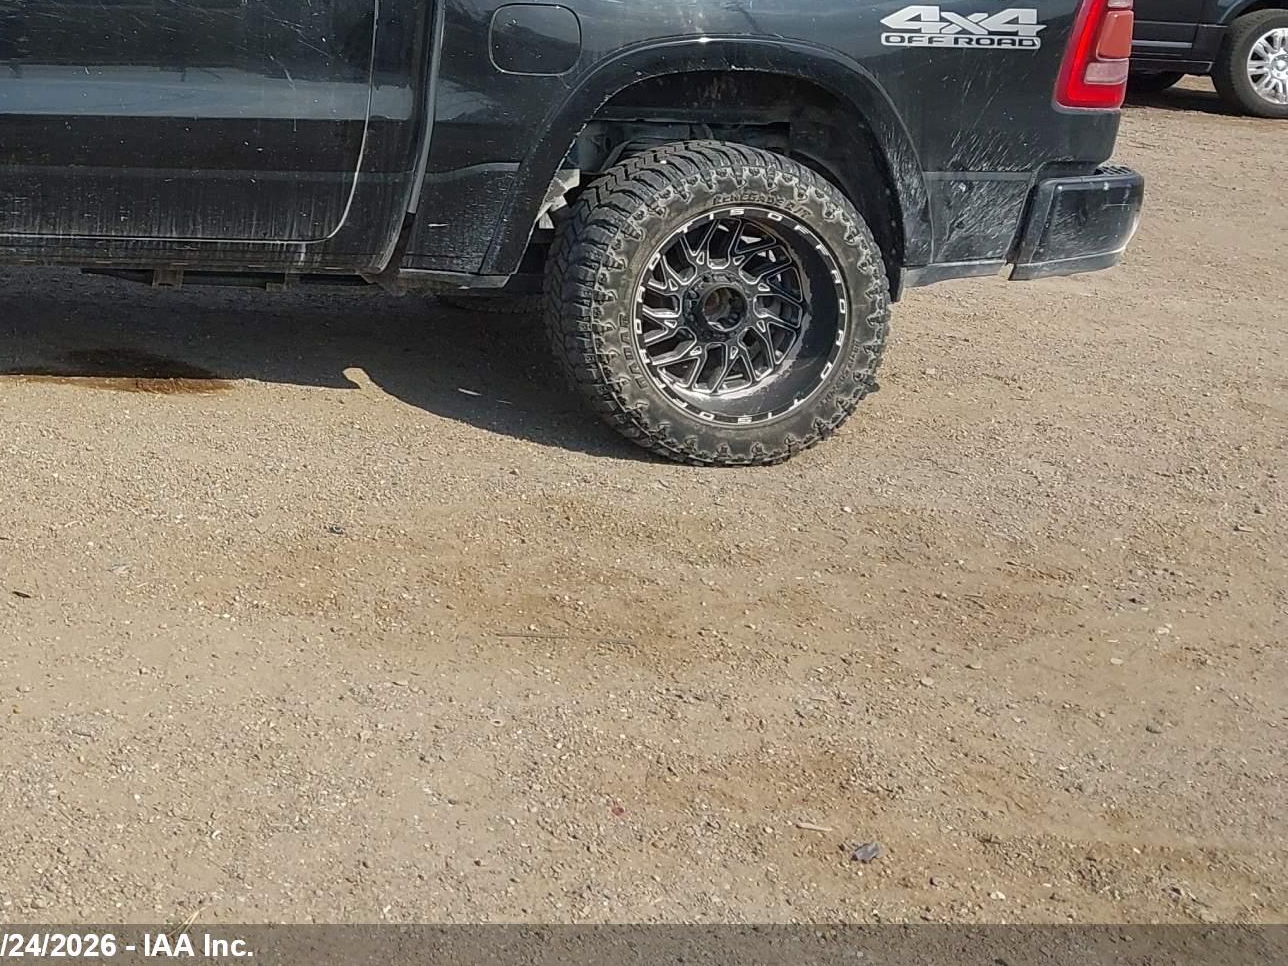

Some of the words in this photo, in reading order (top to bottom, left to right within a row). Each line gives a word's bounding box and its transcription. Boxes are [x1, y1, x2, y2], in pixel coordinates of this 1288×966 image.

[880, 5, 1047, 36] 4x4
[884, 35, 946, 46] OFF
[954, 37, 1040, 47] ROAD
